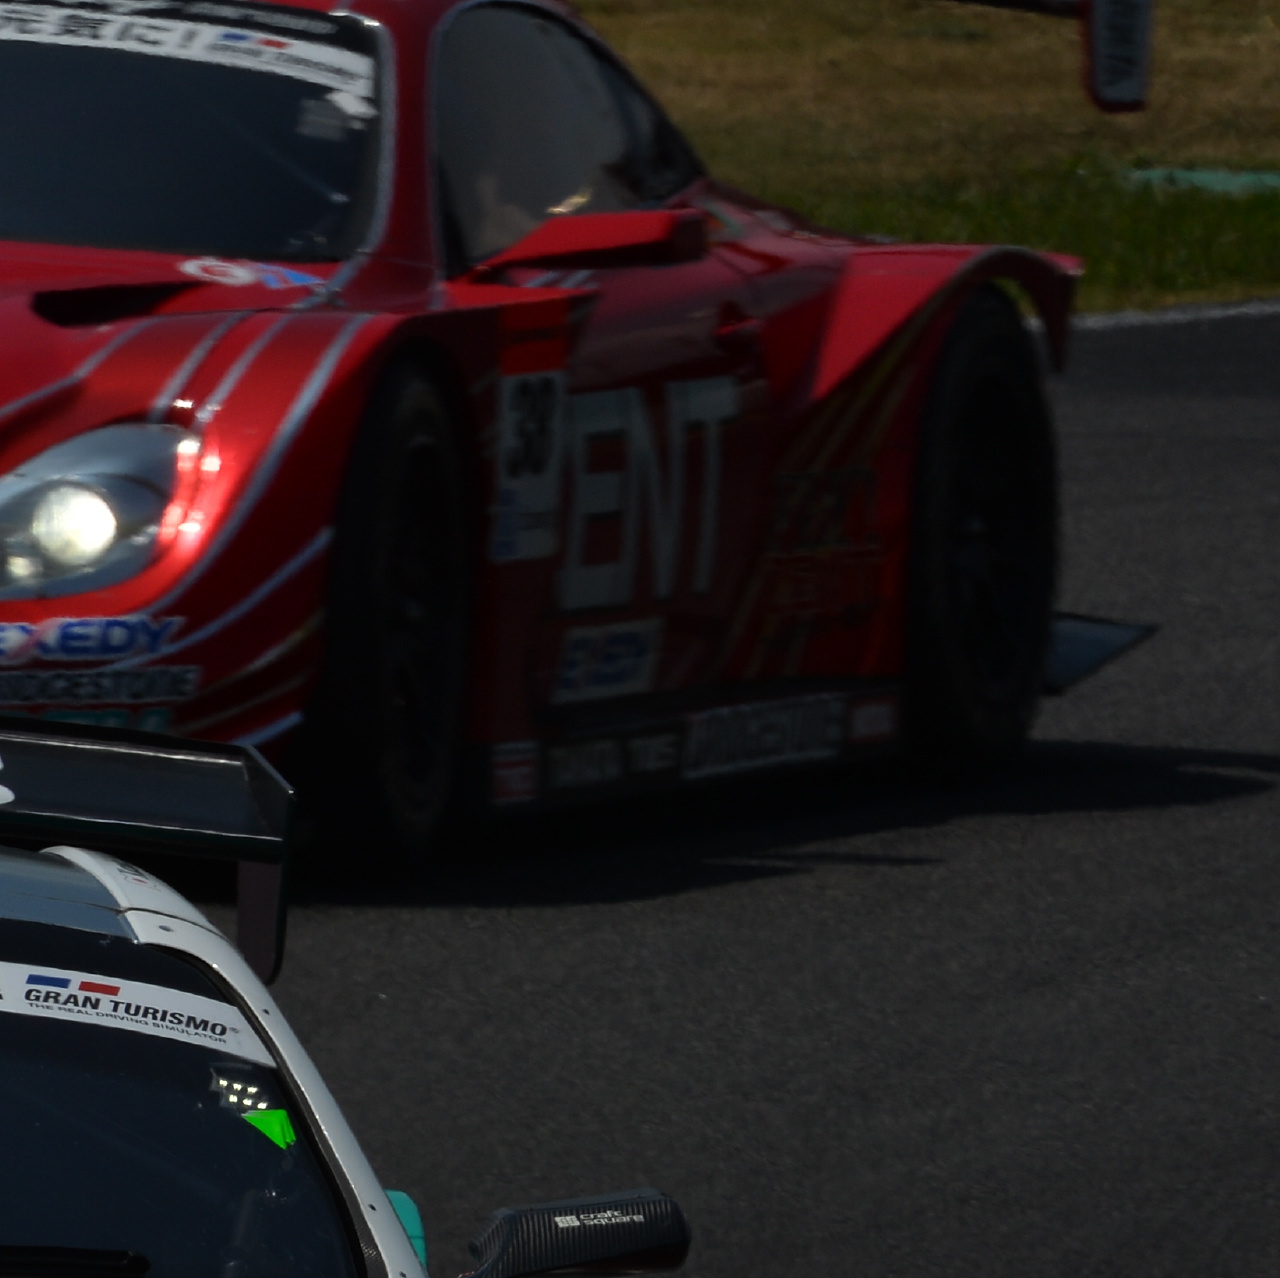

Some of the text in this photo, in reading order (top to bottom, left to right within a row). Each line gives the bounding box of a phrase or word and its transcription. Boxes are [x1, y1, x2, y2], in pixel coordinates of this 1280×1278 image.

[25, 988, 101, 1010] GRAN
[27, 1003, 228, 1044] THE REAL DRIVING SIMULATOR
[582, 1214, 646, 1226] square
